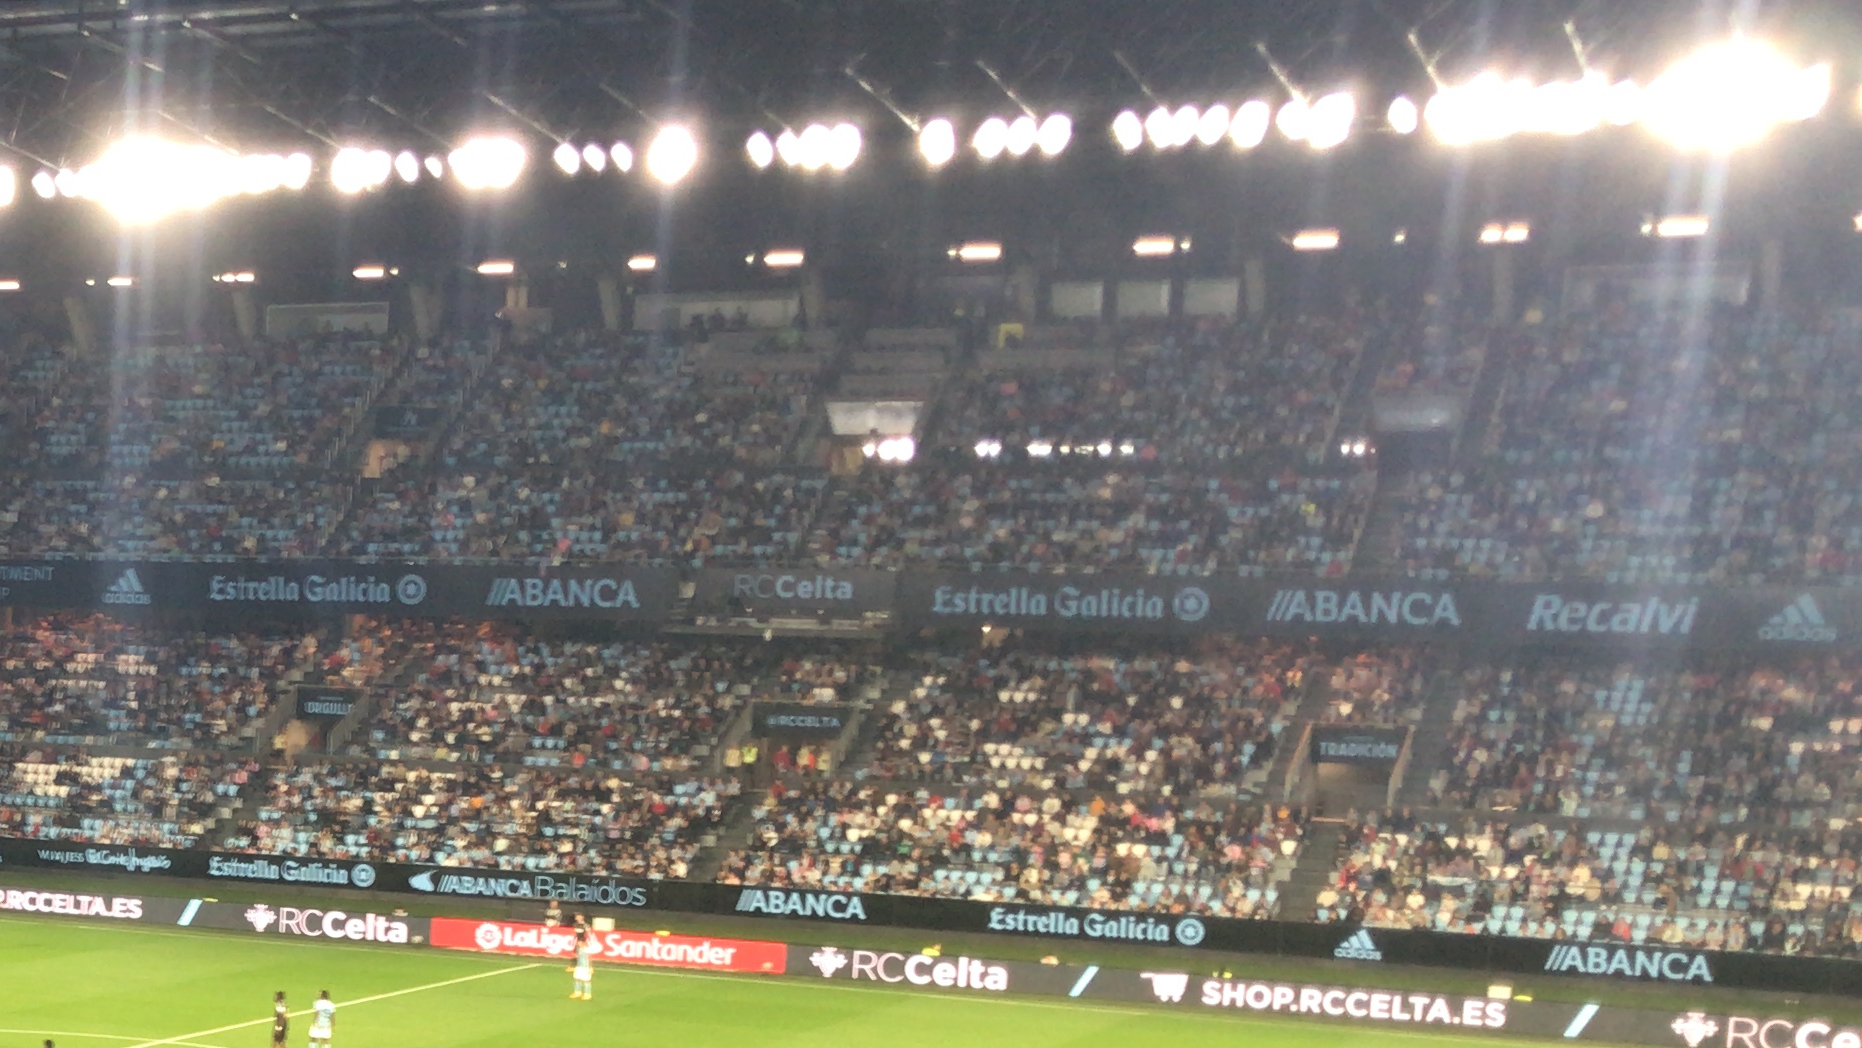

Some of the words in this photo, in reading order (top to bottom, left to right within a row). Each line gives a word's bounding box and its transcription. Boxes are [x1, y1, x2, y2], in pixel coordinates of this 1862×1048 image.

[208, 574, 300, 602] Estrella
[303, 574, 391, 602] Galicia
[931, 585, 1048, 616] Estrella
[1054, 586, 1164, 619] Galicia
[1526, 594, 1700, 635] Recalvi
[208, 855, 280, 880] Estrella
[281, 860, 349, 885] Galicia
[987, 907, 1080, 936] Estrella
[1083, 912, 1170, 943] Galicia
[604, 936, 738, 966] Santander
[1333, 947, 1383, 962] adidas
[1200, 980, 1507, 1029] SHOP.RCCELTA.ES
